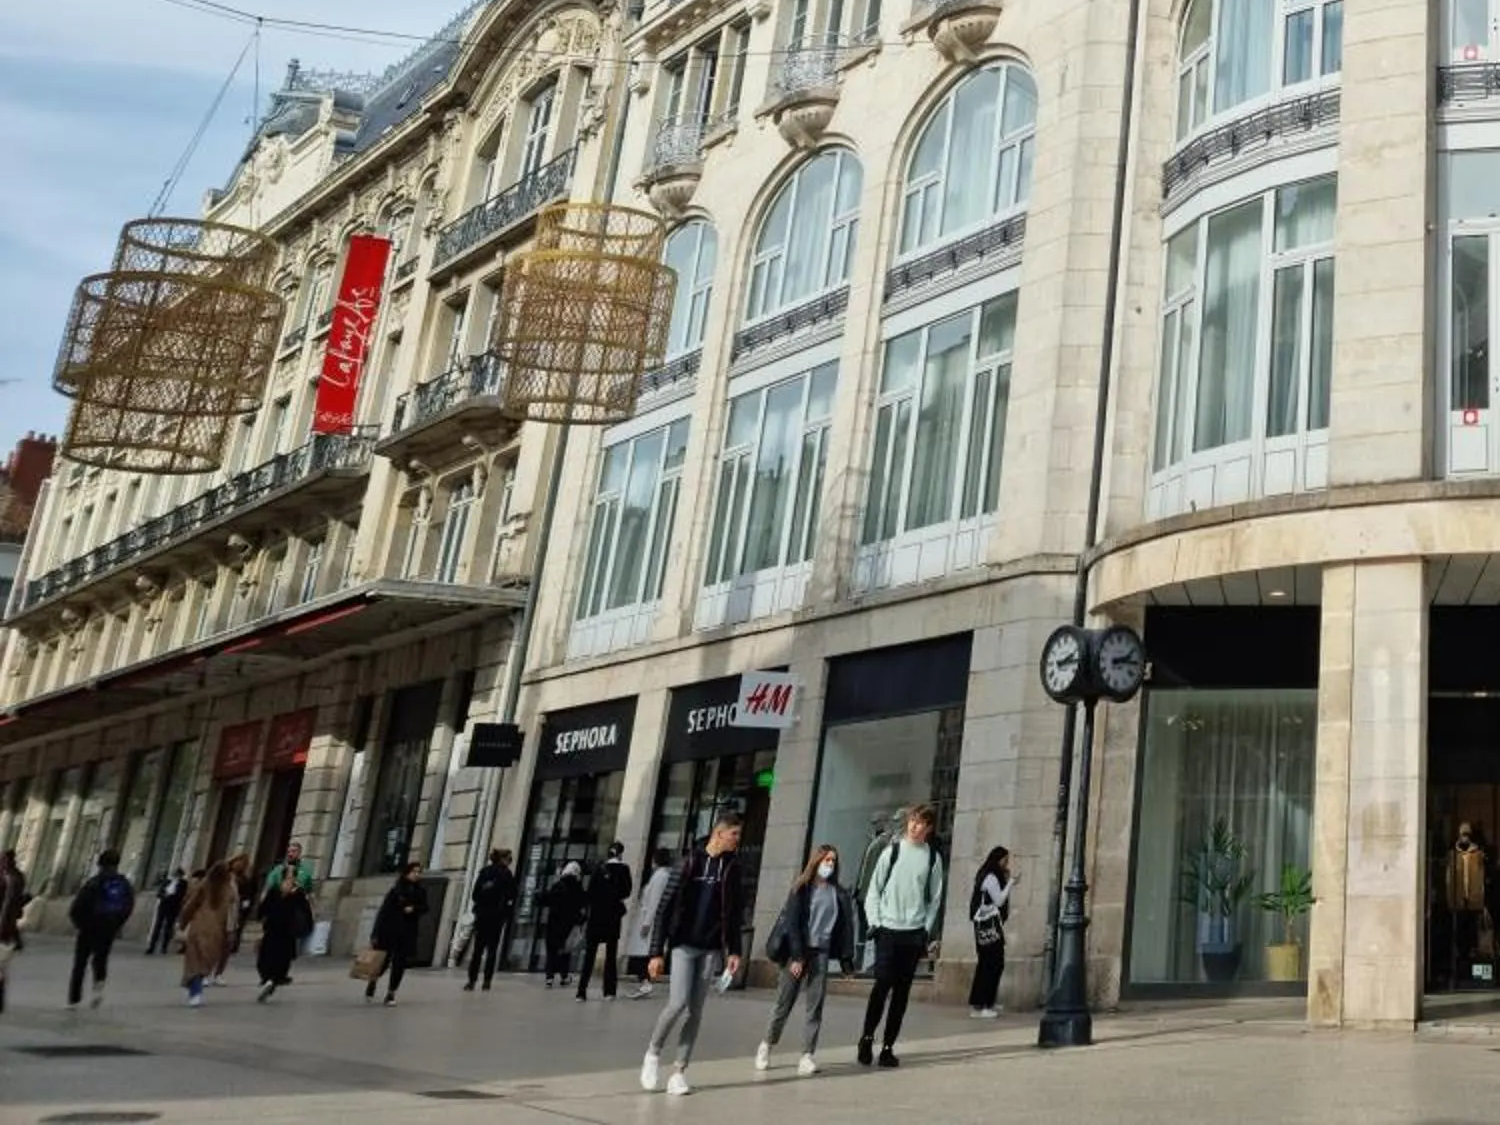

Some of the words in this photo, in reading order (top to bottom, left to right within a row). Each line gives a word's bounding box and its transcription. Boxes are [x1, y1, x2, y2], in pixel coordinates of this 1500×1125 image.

[744, 682, 793, 716] H&M
[687, 701, 741, 733] SEPHO
[553, 723, 617, 755] SEPHORA
